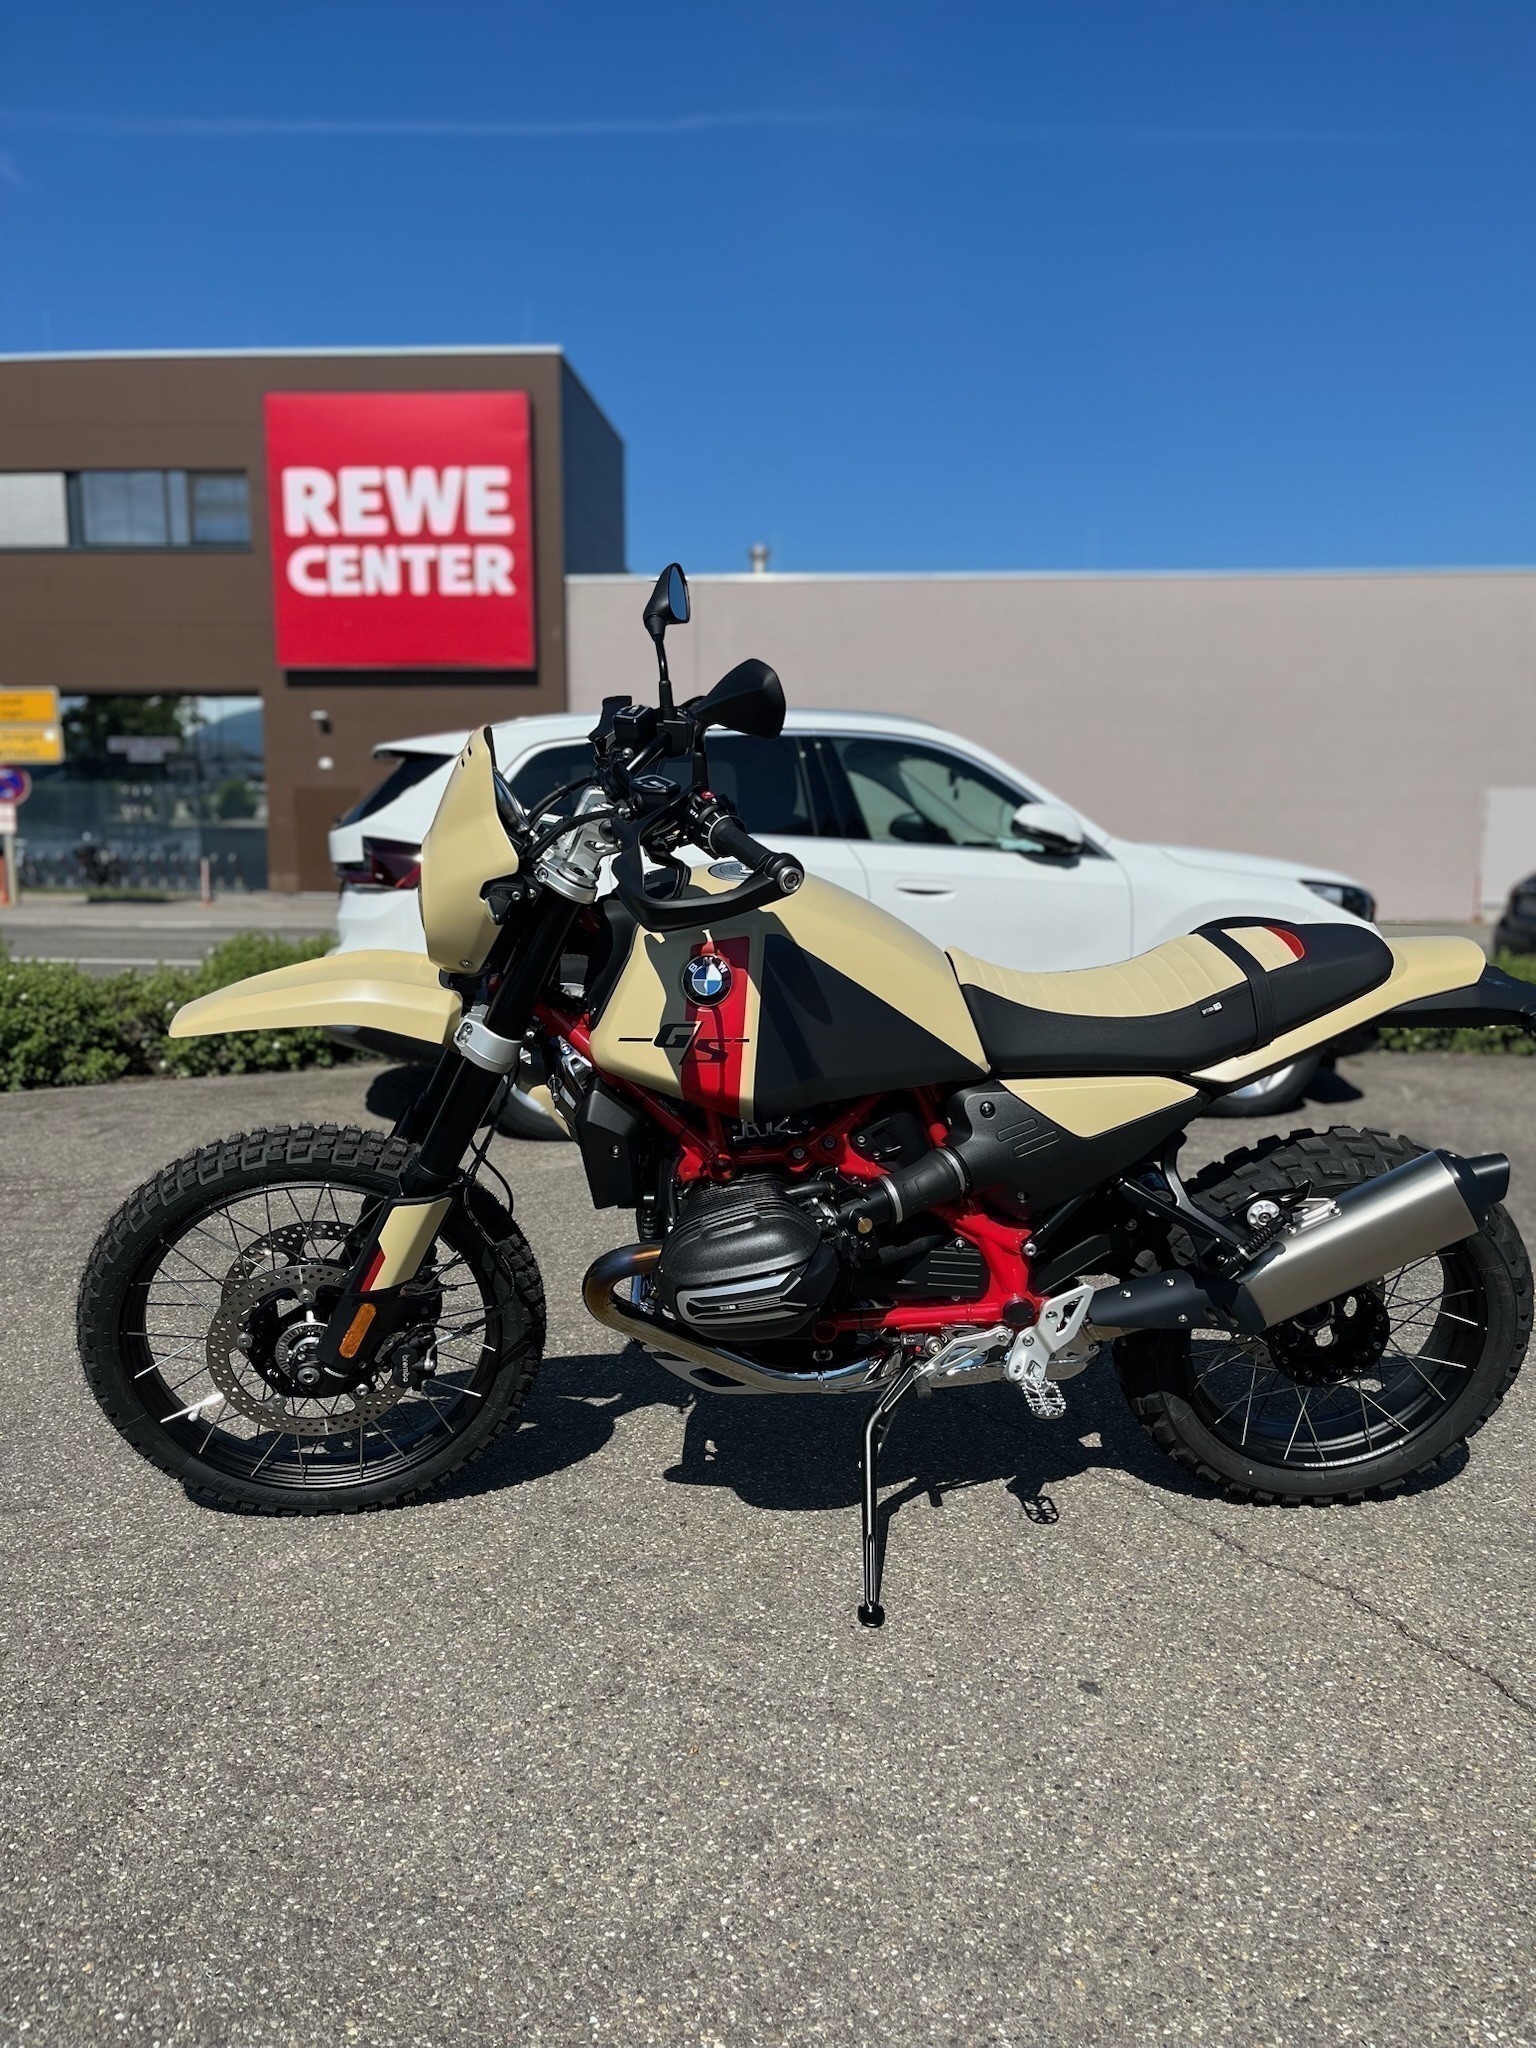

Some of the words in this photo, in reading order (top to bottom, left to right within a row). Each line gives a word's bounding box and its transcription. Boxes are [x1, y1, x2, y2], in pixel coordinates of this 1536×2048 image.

[282, 465, 515, 537] REWE
[286, 544, 516, 597] CENTER
[402, 1354, 410, 1383] brembo
